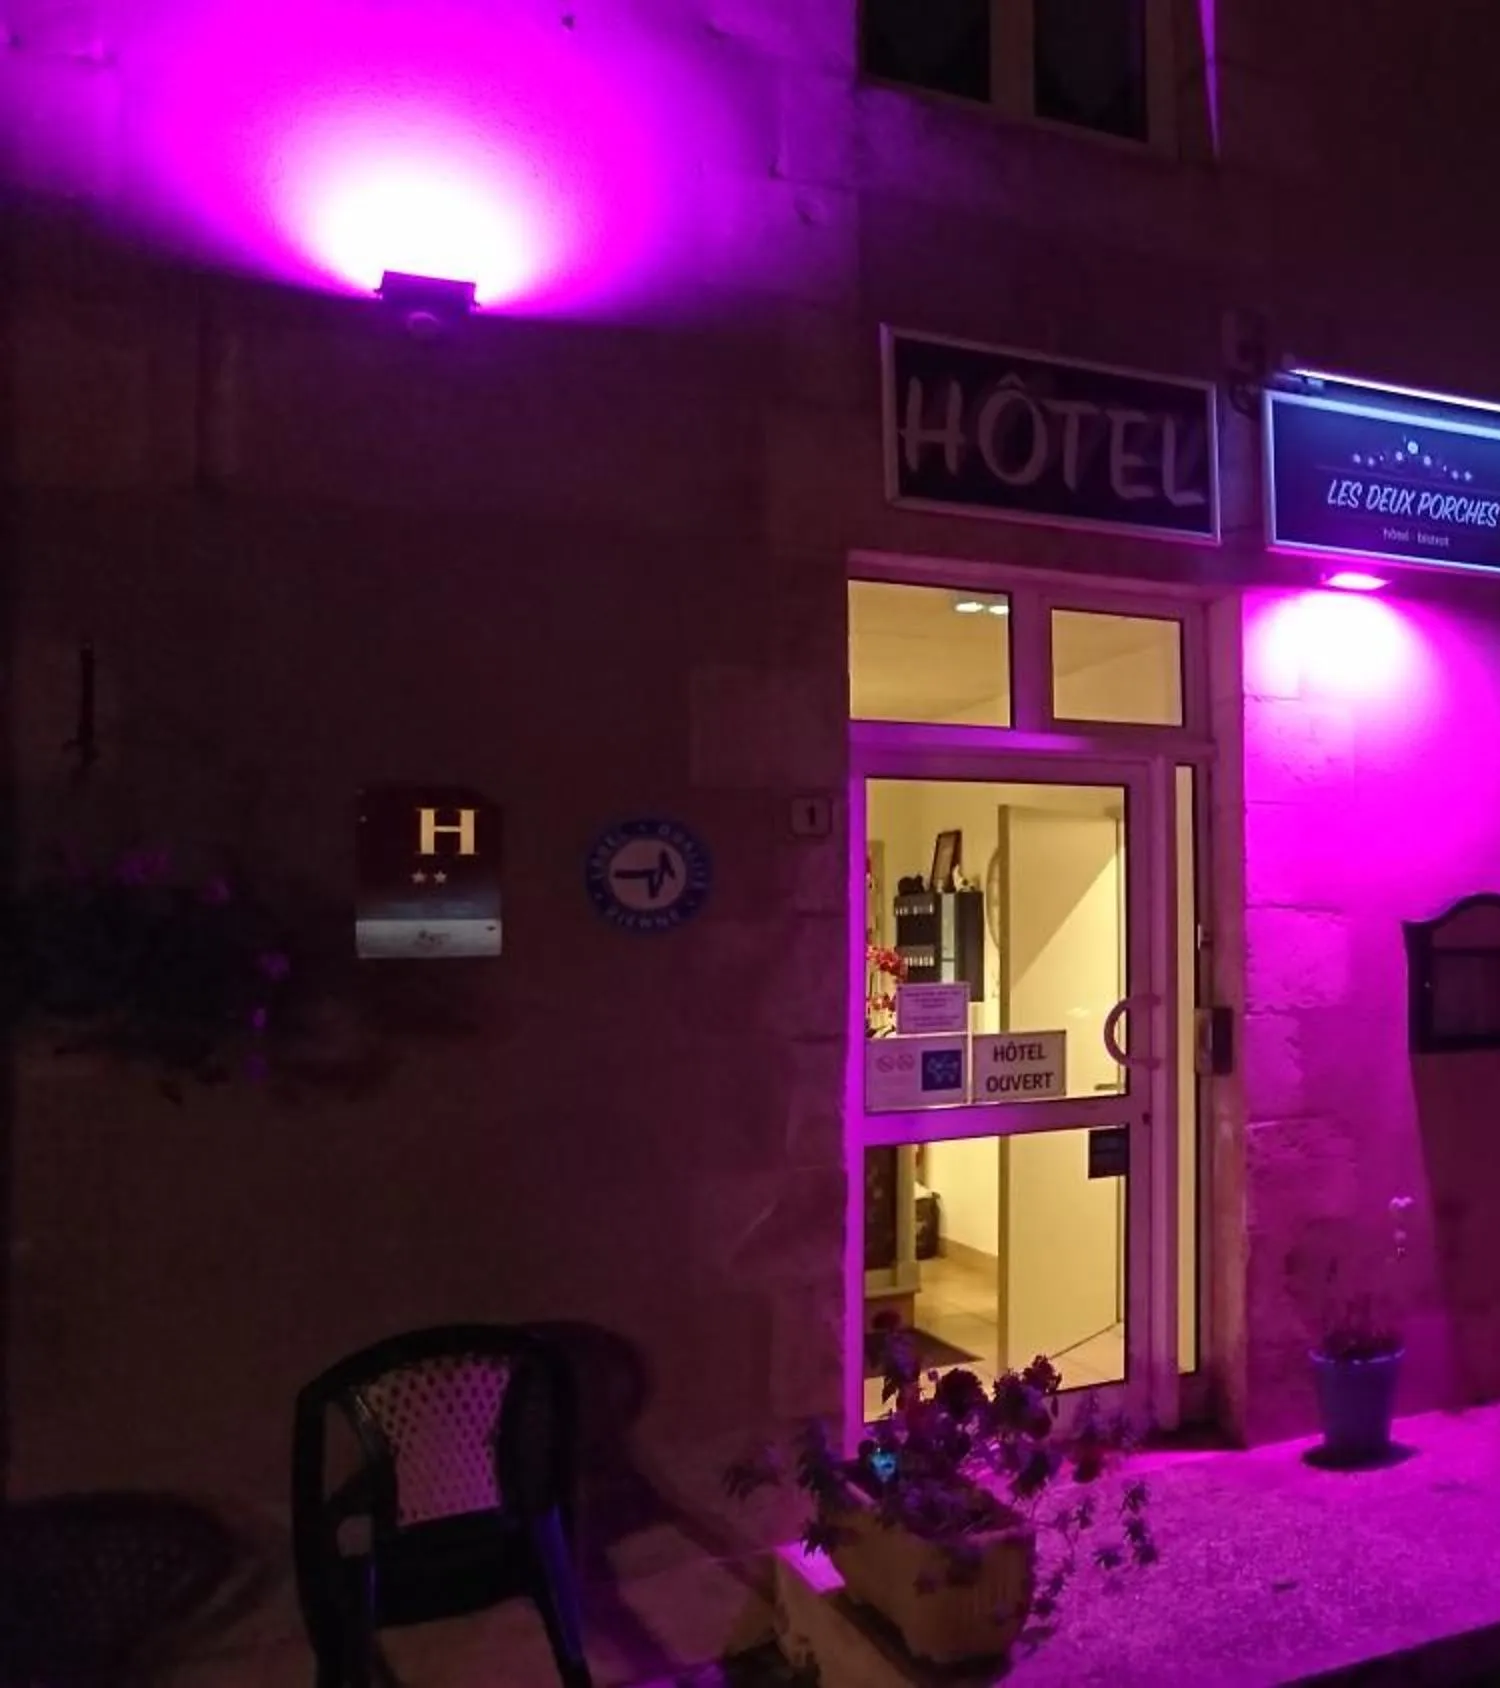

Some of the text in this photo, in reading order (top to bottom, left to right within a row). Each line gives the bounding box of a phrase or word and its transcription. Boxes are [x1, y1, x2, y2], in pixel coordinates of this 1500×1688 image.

[898, 371, 1206, 507] HÔTEL
[1327, 478, 1500, 528] LES DEUX PORCHES
[415, 806, 480, 857] H
[806, 805, 816, 827] 1
[993, 1040, 1048, 1063] HÔTEL
[986, 1071, 1055, 1093] OUVERT
